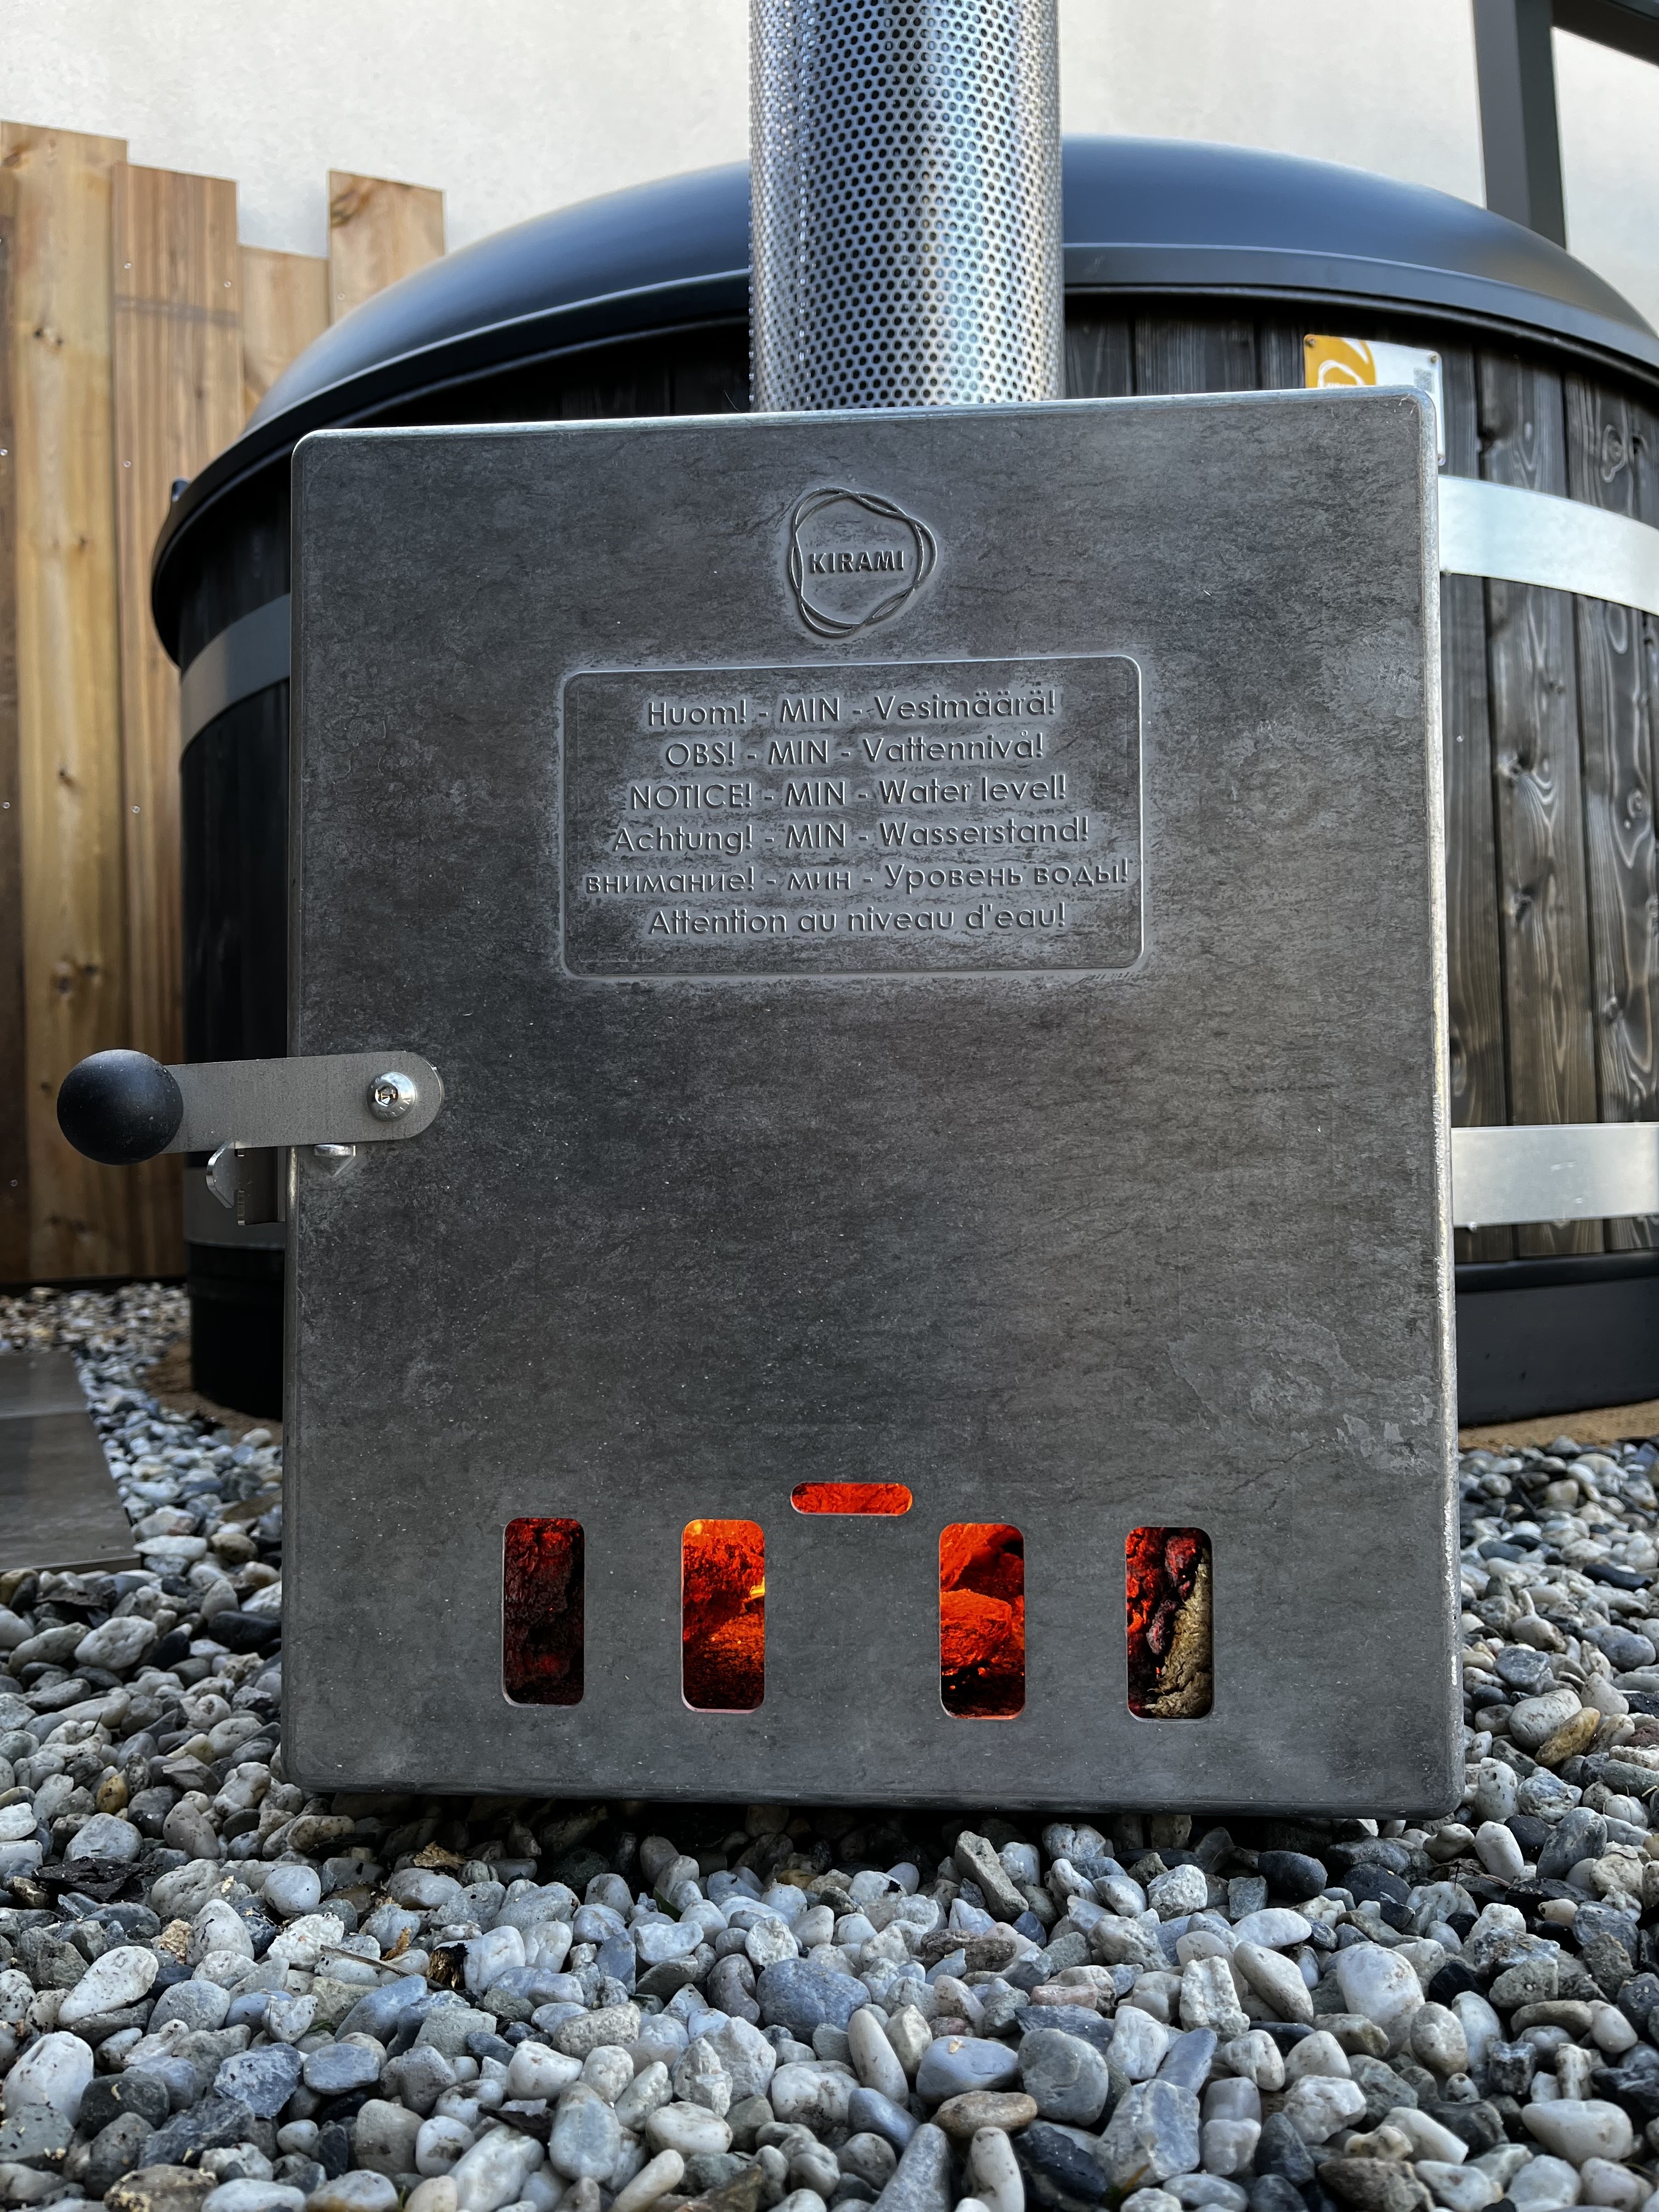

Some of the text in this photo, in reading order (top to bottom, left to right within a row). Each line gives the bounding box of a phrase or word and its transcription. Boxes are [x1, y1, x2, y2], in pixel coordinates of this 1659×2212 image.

[810, 550, 904, 573] KIRAMI
[648, 698, 746, 726] Huom!
[781, 697, 840, 723] MIN
[874, 689, 1056, 720] Vesimäärä!
[667, 741, 735, 767] OBS!
[769, 739, 828, 765] MIN
[864, 730, 1043, 763] Vattennivå!
[631, 783, 753, 810] NOTICE!
[786, 781, 846, 807] MIN
[880, 778, 972, 804] Water
[983, 774, 1066, 803] level!
[612, 825, 753, 856] Achtung!
[786, 823, 847, 849] MIN
[880, 816, 1089, 847] Wasserstand!
[586, 866, 755, 894] внимание!
[788, 871, 851, 891] мин
[885, 863, 1023, 894] Уровень
[1035, 857, 1128, 887] воды!
[648, 901, 1066, 935] Attention au niveau d'eau!
